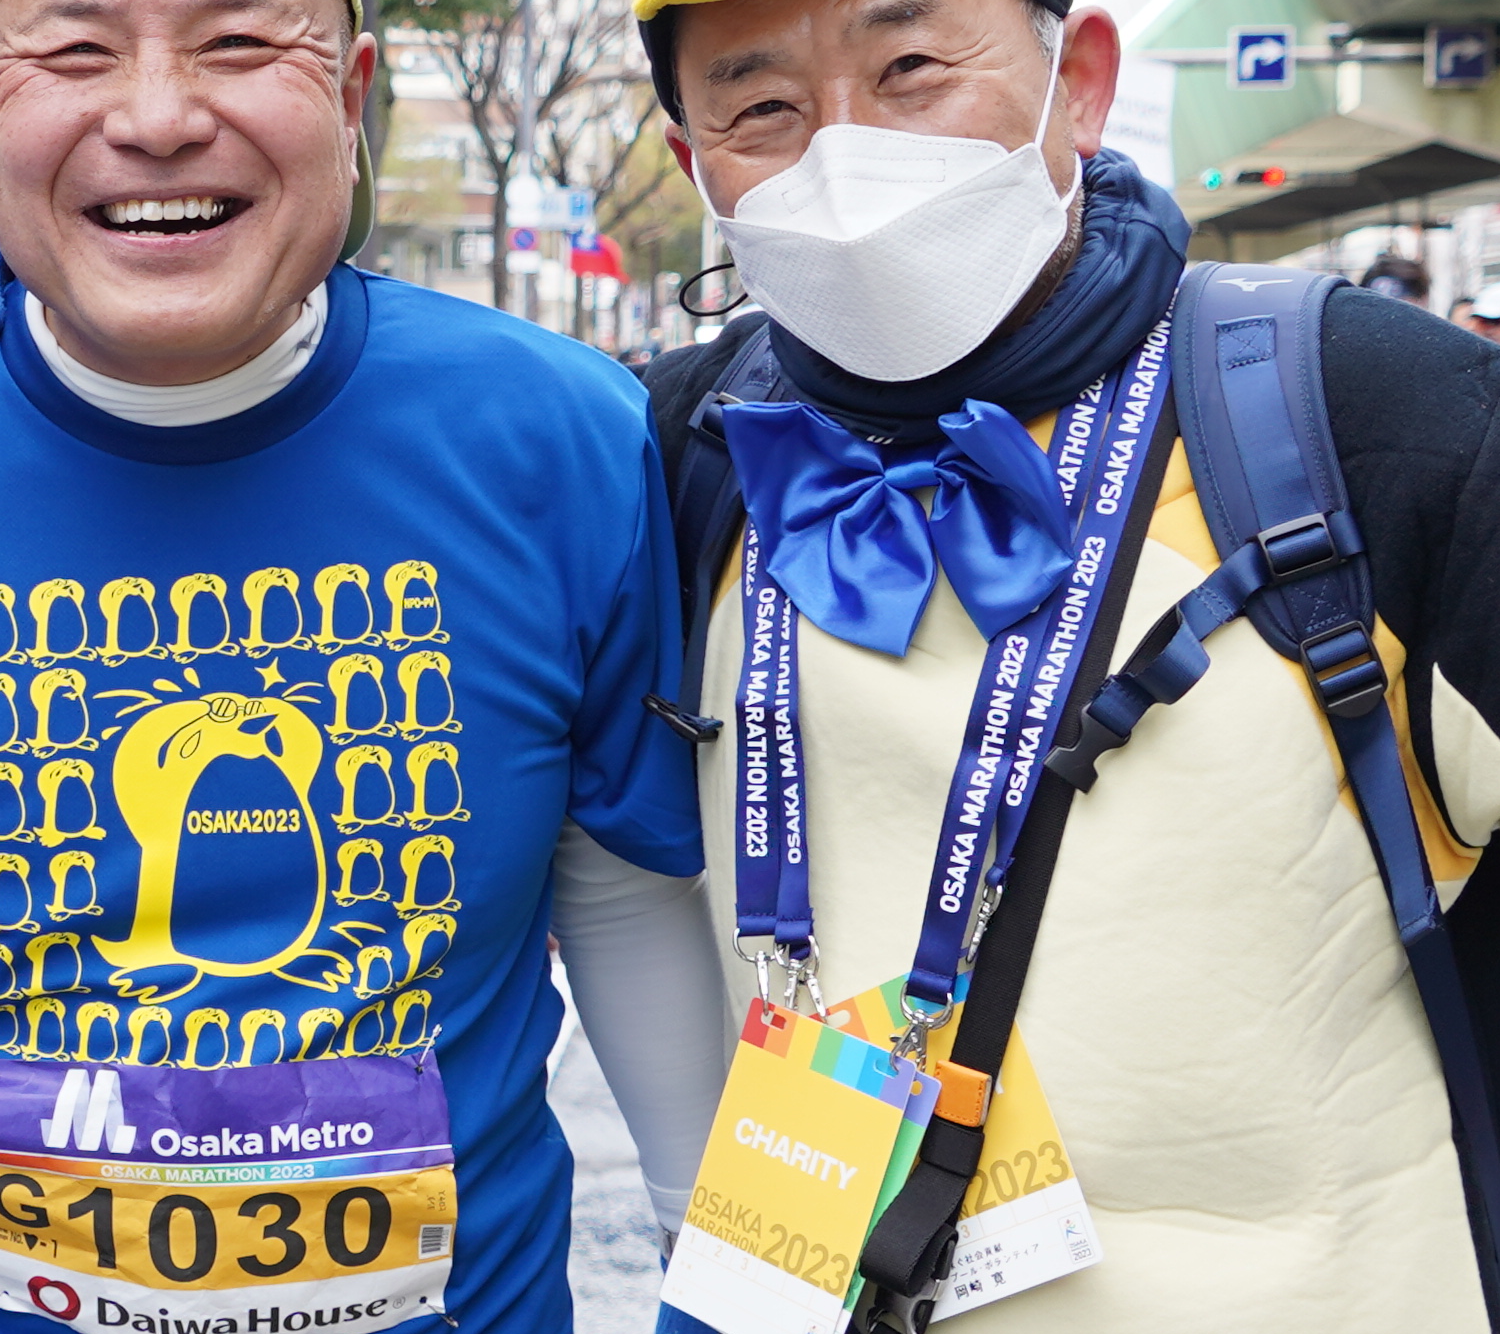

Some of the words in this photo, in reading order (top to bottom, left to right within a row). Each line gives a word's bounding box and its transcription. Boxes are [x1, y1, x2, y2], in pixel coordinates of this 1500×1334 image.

[1095, 438, 1137, 516] OSAKA
[750, 586, 777, 667] OSAKA
[1005, 726, 1044, 807] OSAKA
[1027, 588, 1090, 722] MARATHON
[1071, 535, 1107, 586] 2023
[743, 670, 769, 804] MARATHON
[939, 832, 978, 915] OSAKA
[959, 689, 1011, 828] MARATHON
[995, 634, 1031, 691] 2023
[186, 809, 301, 835] OSAKA2023
[745, 804, 769, 858] 2023
[780, 783, 802, 865] OSAKA
[100, 1164, 161, 1181] OSAKA
[165, 1163, 266, 1181] MARATHON
[269, 1163, 316, 1180] 2023
[150, 1128, 263, 1158] Osaka
[270, 1120, 375, 1155] Metro
[734, 1116, 859, 1192] CHARITY
[691, 1185, 762, 1240] OSAKA
[972, 1140, 1071, 1213] 2023
[684, 1210, 760, 1257] MARATHON
[760, 1223, 851, 1297] 2023
[959, 1223, 972, 1239] 3
[247, 1297, 389, 1334] House
